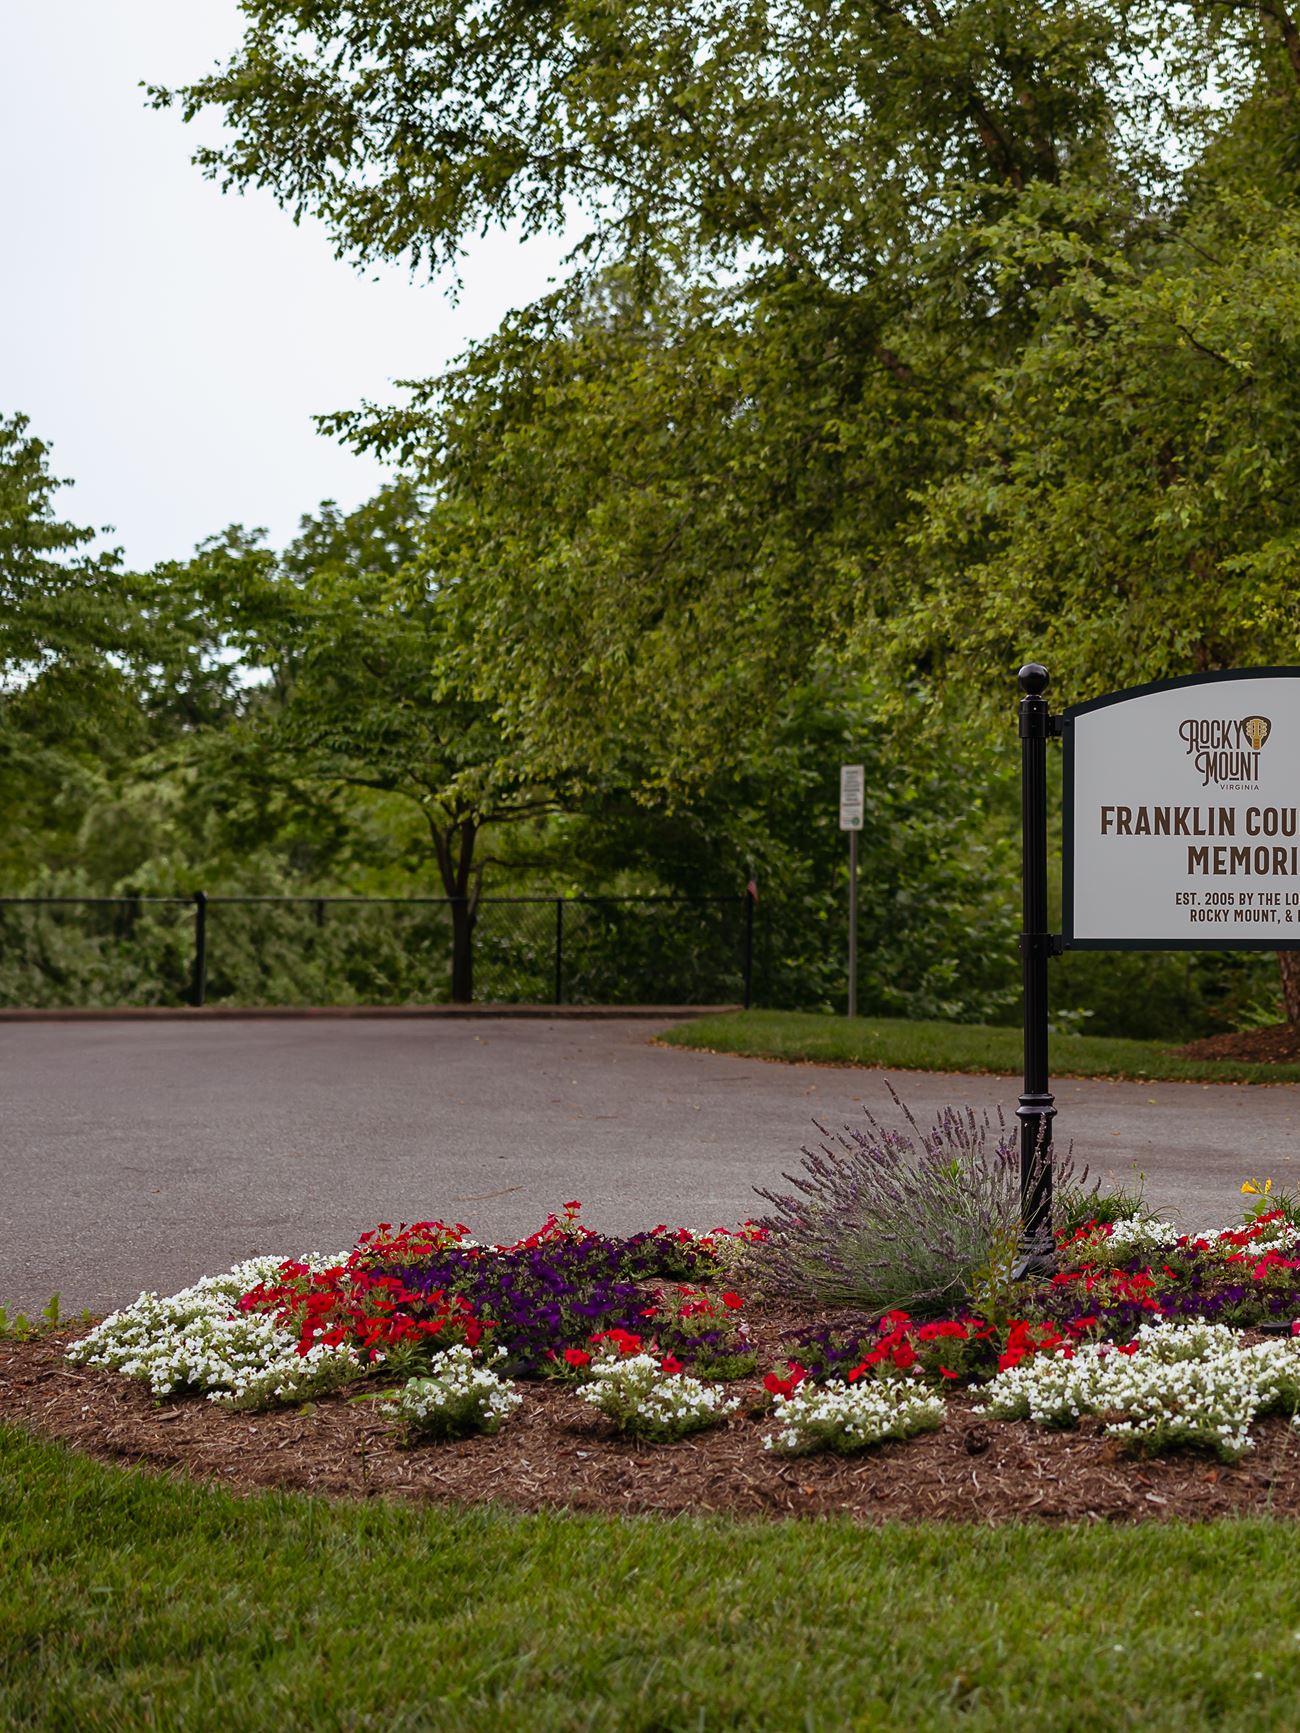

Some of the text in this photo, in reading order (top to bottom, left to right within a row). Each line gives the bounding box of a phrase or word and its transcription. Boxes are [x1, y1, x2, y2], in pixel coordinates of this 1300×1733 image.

[1179, 719, 1243, 754] ROCKY
[1195, 751, 1261, 786] MOUNT
[1101, 806, 1235, 836] FRANKLIN
[1176, 893, 1200, 905] EST.
[1205, 893, 1234, 906] 2005
[1239, 893, 1254, 905] BY
[1258, 893, 1280, 905] THE
[1190, 909, 1229, 922] ROCKY
[1234, 909, 1280, 924] MOUNT,
[1285, 909, 1293, 922] &
